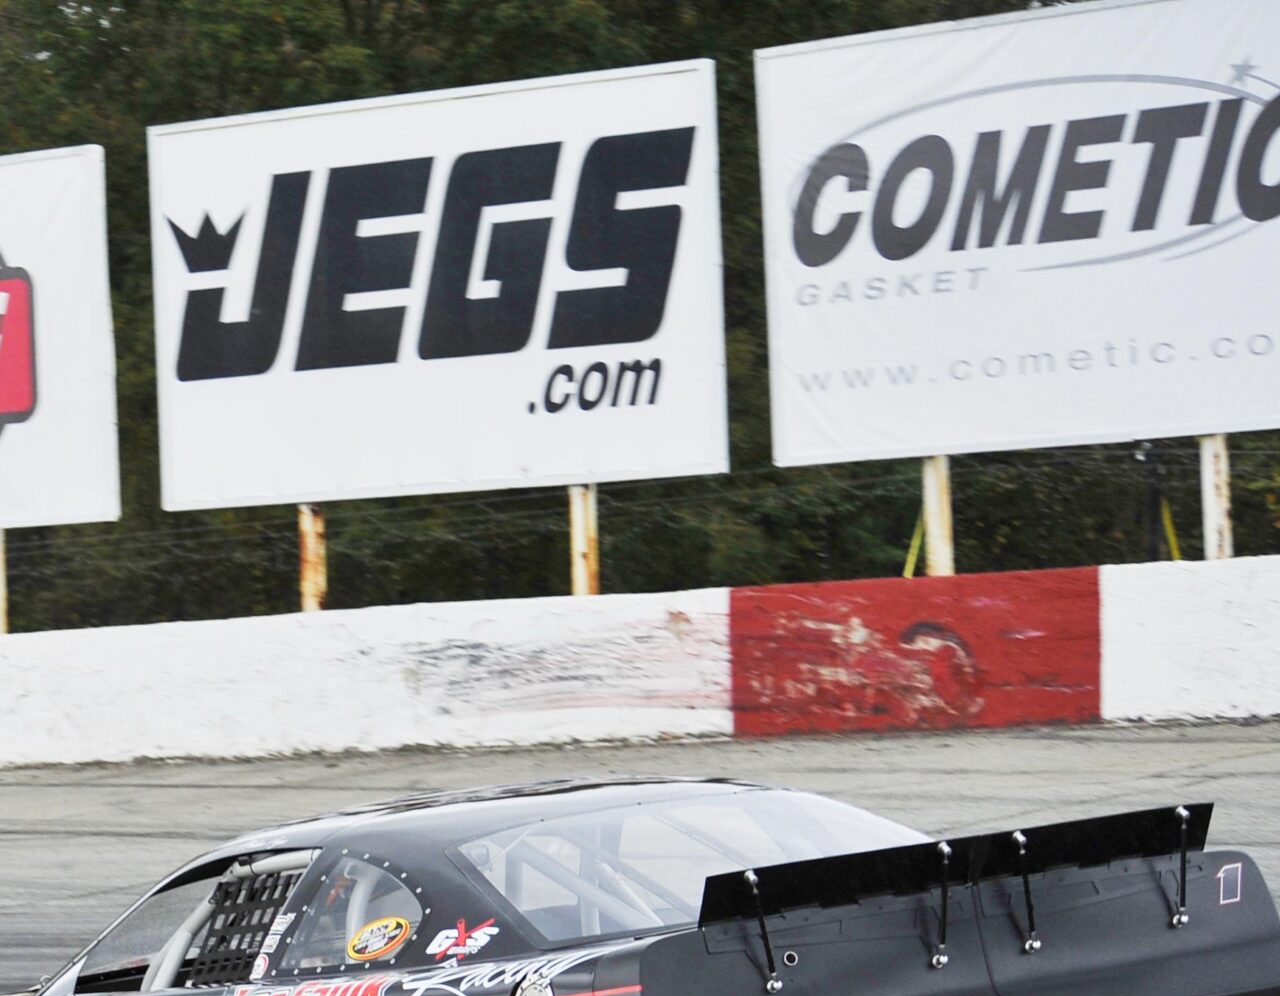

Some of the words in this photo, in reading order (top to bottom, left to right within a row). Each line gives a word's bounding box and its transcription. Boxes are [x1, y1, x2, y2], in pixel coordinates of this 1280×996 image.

[792, 92, 1280, 268] COMETIC
[176, 127, 697, 382] JEGS
[796, 267, 988, 307] GASKET
[527, 356, 663, 416] .com
[1216, 863, 1242, 904] 1
